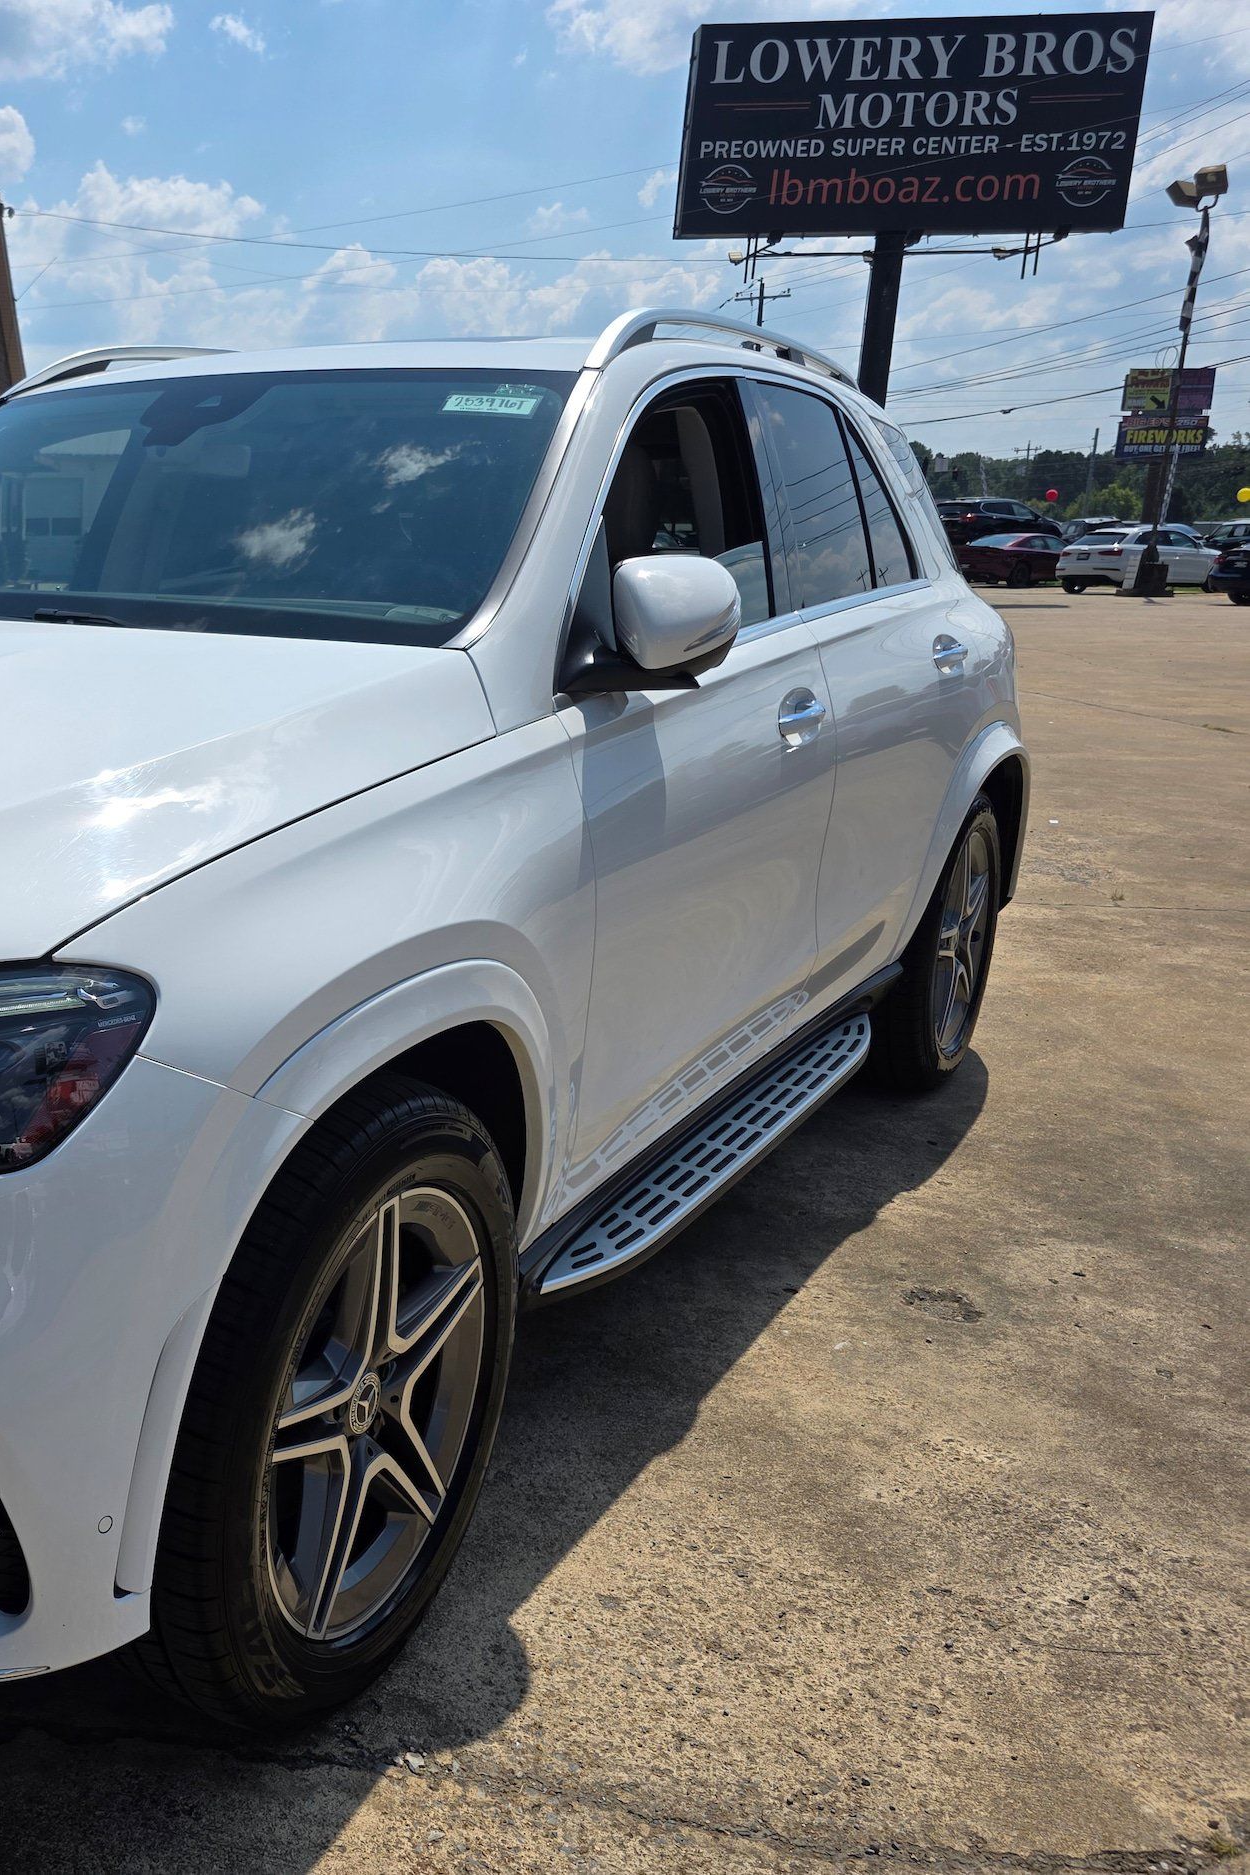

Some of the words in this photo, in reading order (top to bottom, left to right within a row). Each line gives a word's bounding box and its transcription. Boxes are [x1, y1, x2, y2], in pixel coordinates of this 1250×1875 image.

[710, 35, 965, 84] LOWERY
[978, 28, 1137, 78] BROS
[814, 88, 1018, 129] MOTORS
[700, 139, 825, 159] PREOWNED
[831, 137, 905, 157] SUPER
[913, 135, 999, 155] CENTER
[1020, 131, 1127, 153] EST.1972
[769, 168, 1041, 206] lbmboaz.com
